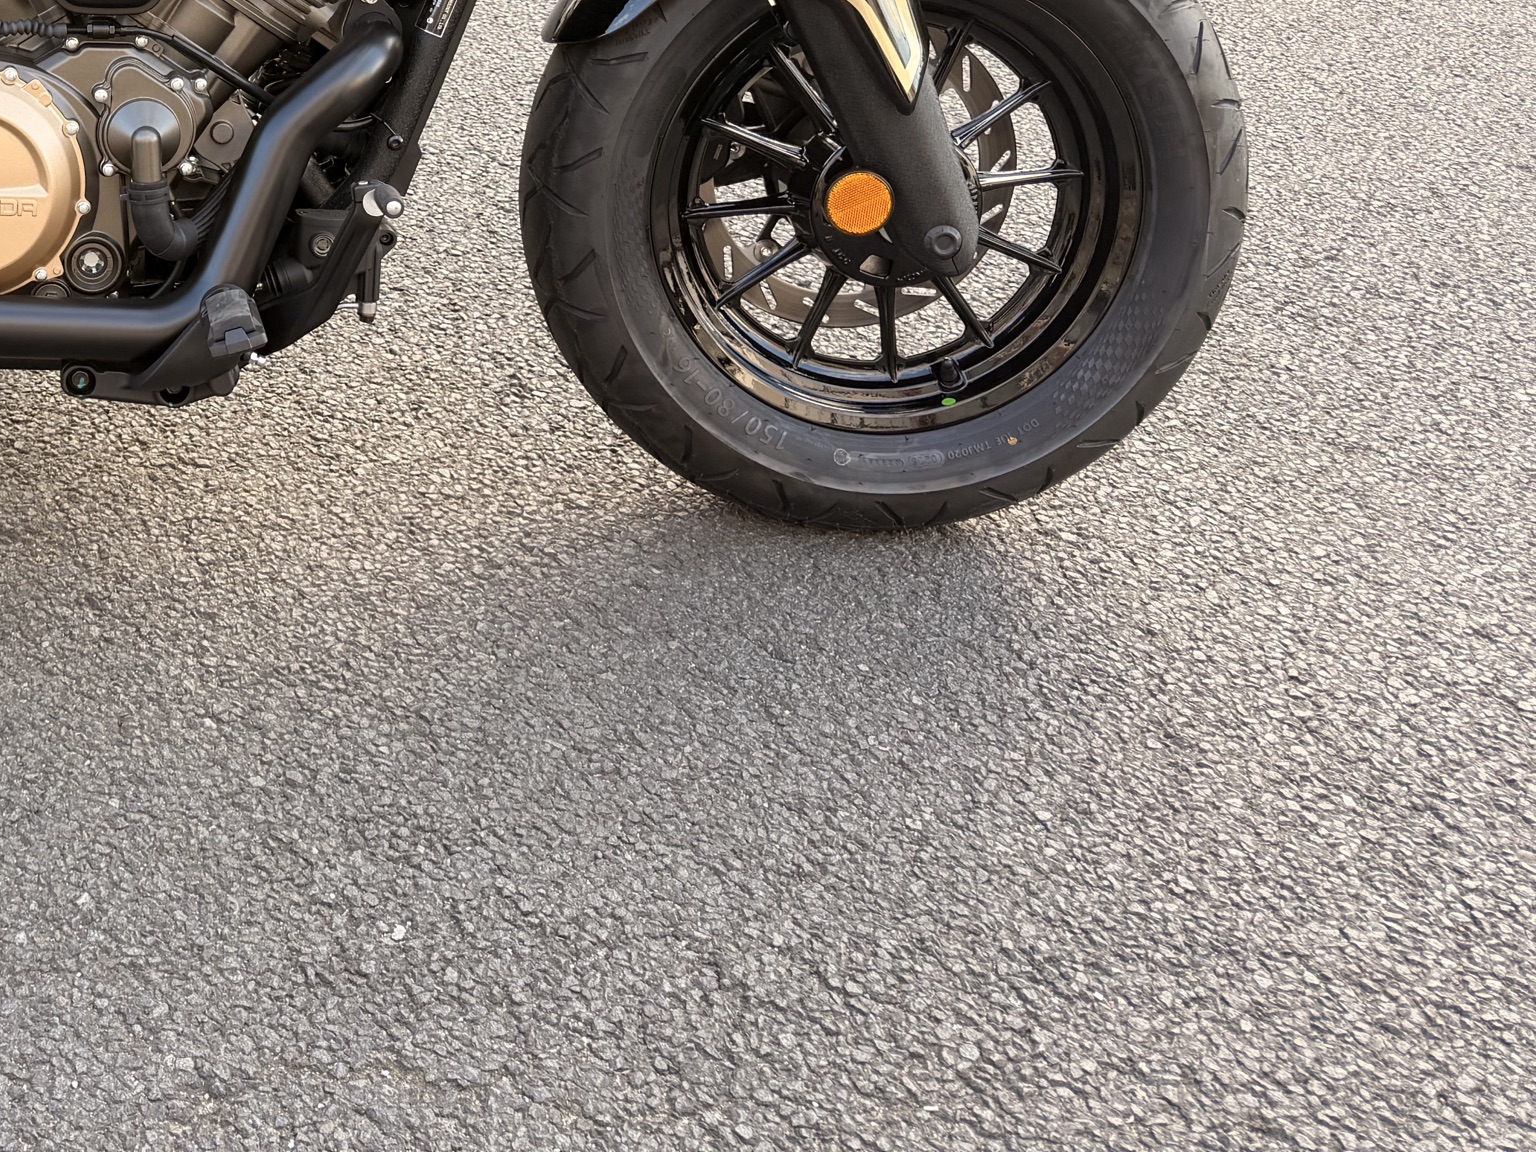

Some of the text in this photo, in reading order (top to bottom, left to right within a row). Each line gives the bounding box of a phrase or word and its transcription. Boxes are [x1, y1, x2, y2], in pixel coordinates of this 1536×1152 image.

[672, 356, 788, 450] 150/80-16
[1019, 418, 1040, 436] DOT
[947, 445, 991, 460] TMJ020
